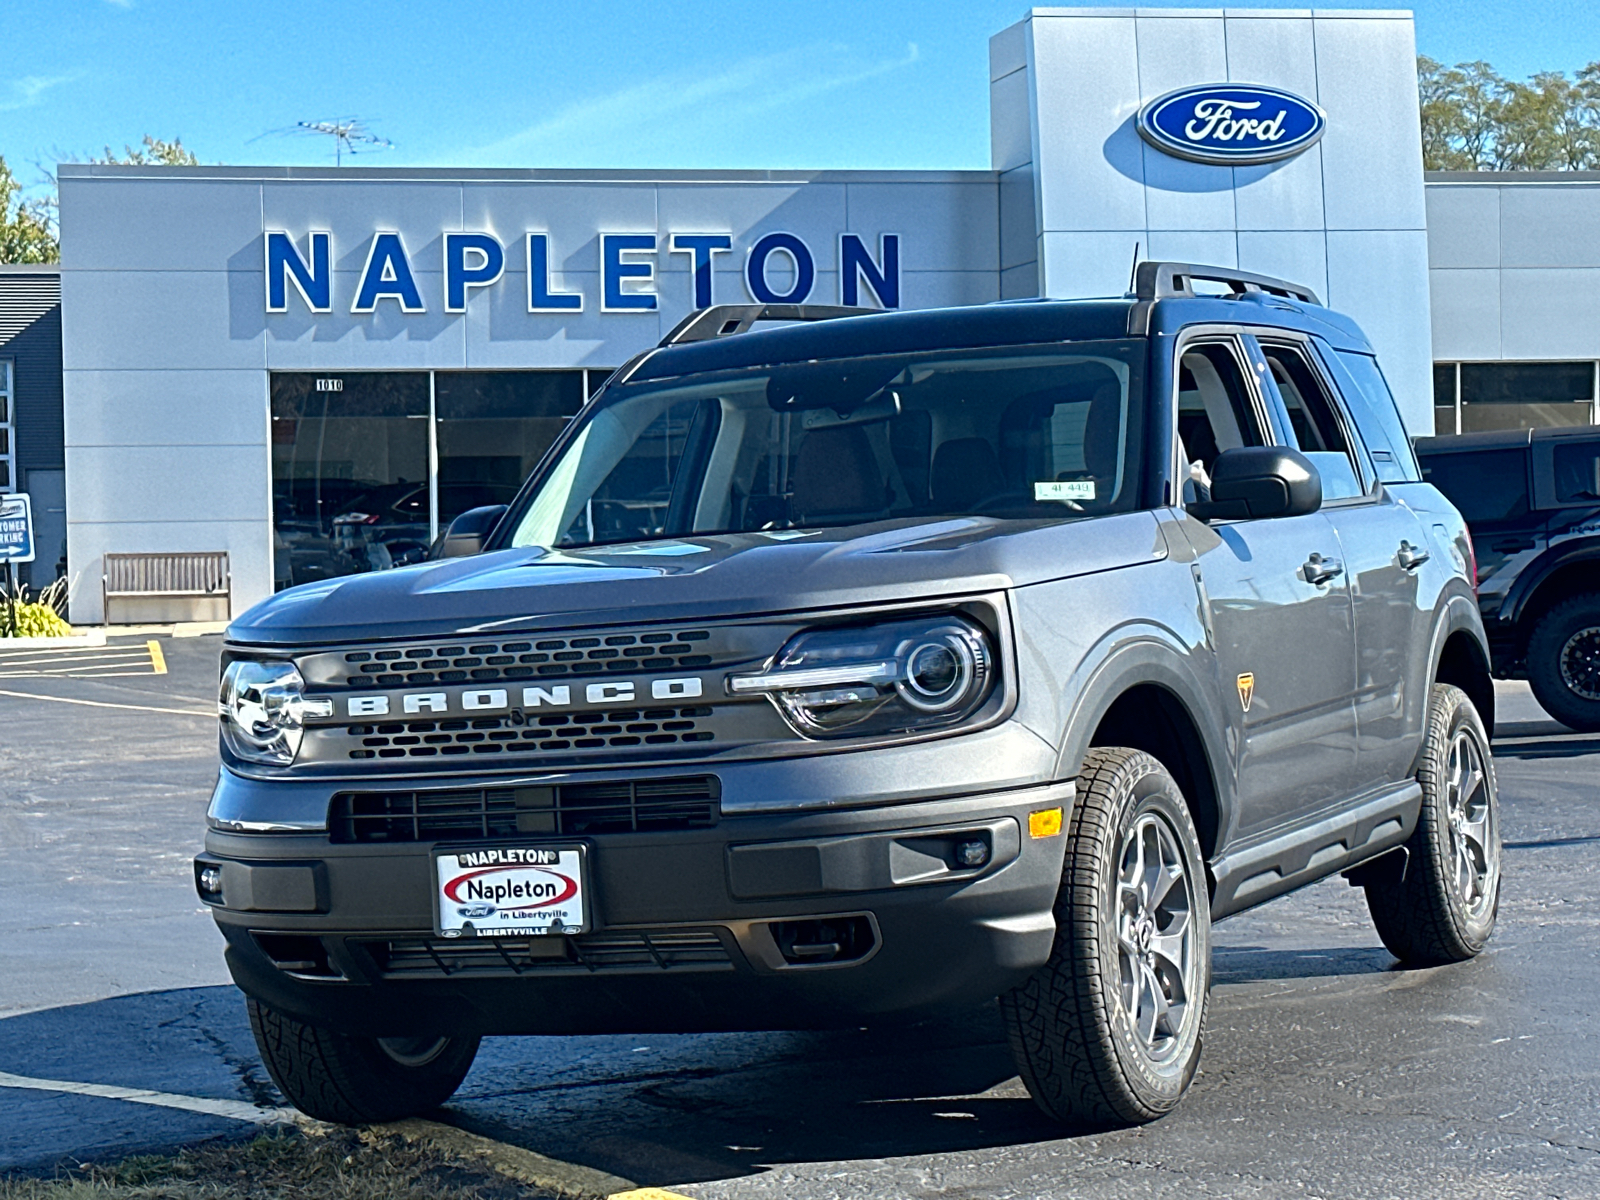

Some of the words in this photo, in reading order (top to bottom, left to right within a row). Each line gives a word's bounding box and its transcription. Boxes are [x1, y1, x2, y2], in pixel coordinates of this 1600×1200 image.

[1184, 98, 1288, 141] Ford
[264, 230, 902, 314] NAPLETON
[318, 379, 342, 391] 1010
[347, 677, 703, 717] BRONCO
[465, 849, 549, 867] NAPLETON
[466, 878, 557, 904] Napleton
[464, 906, 490, 917] Ford
[500, 911, 510, 920] in
[512, 909, 569, 920] Libertyville
[476, 927, 548, 937] LIBERTYVILLE
